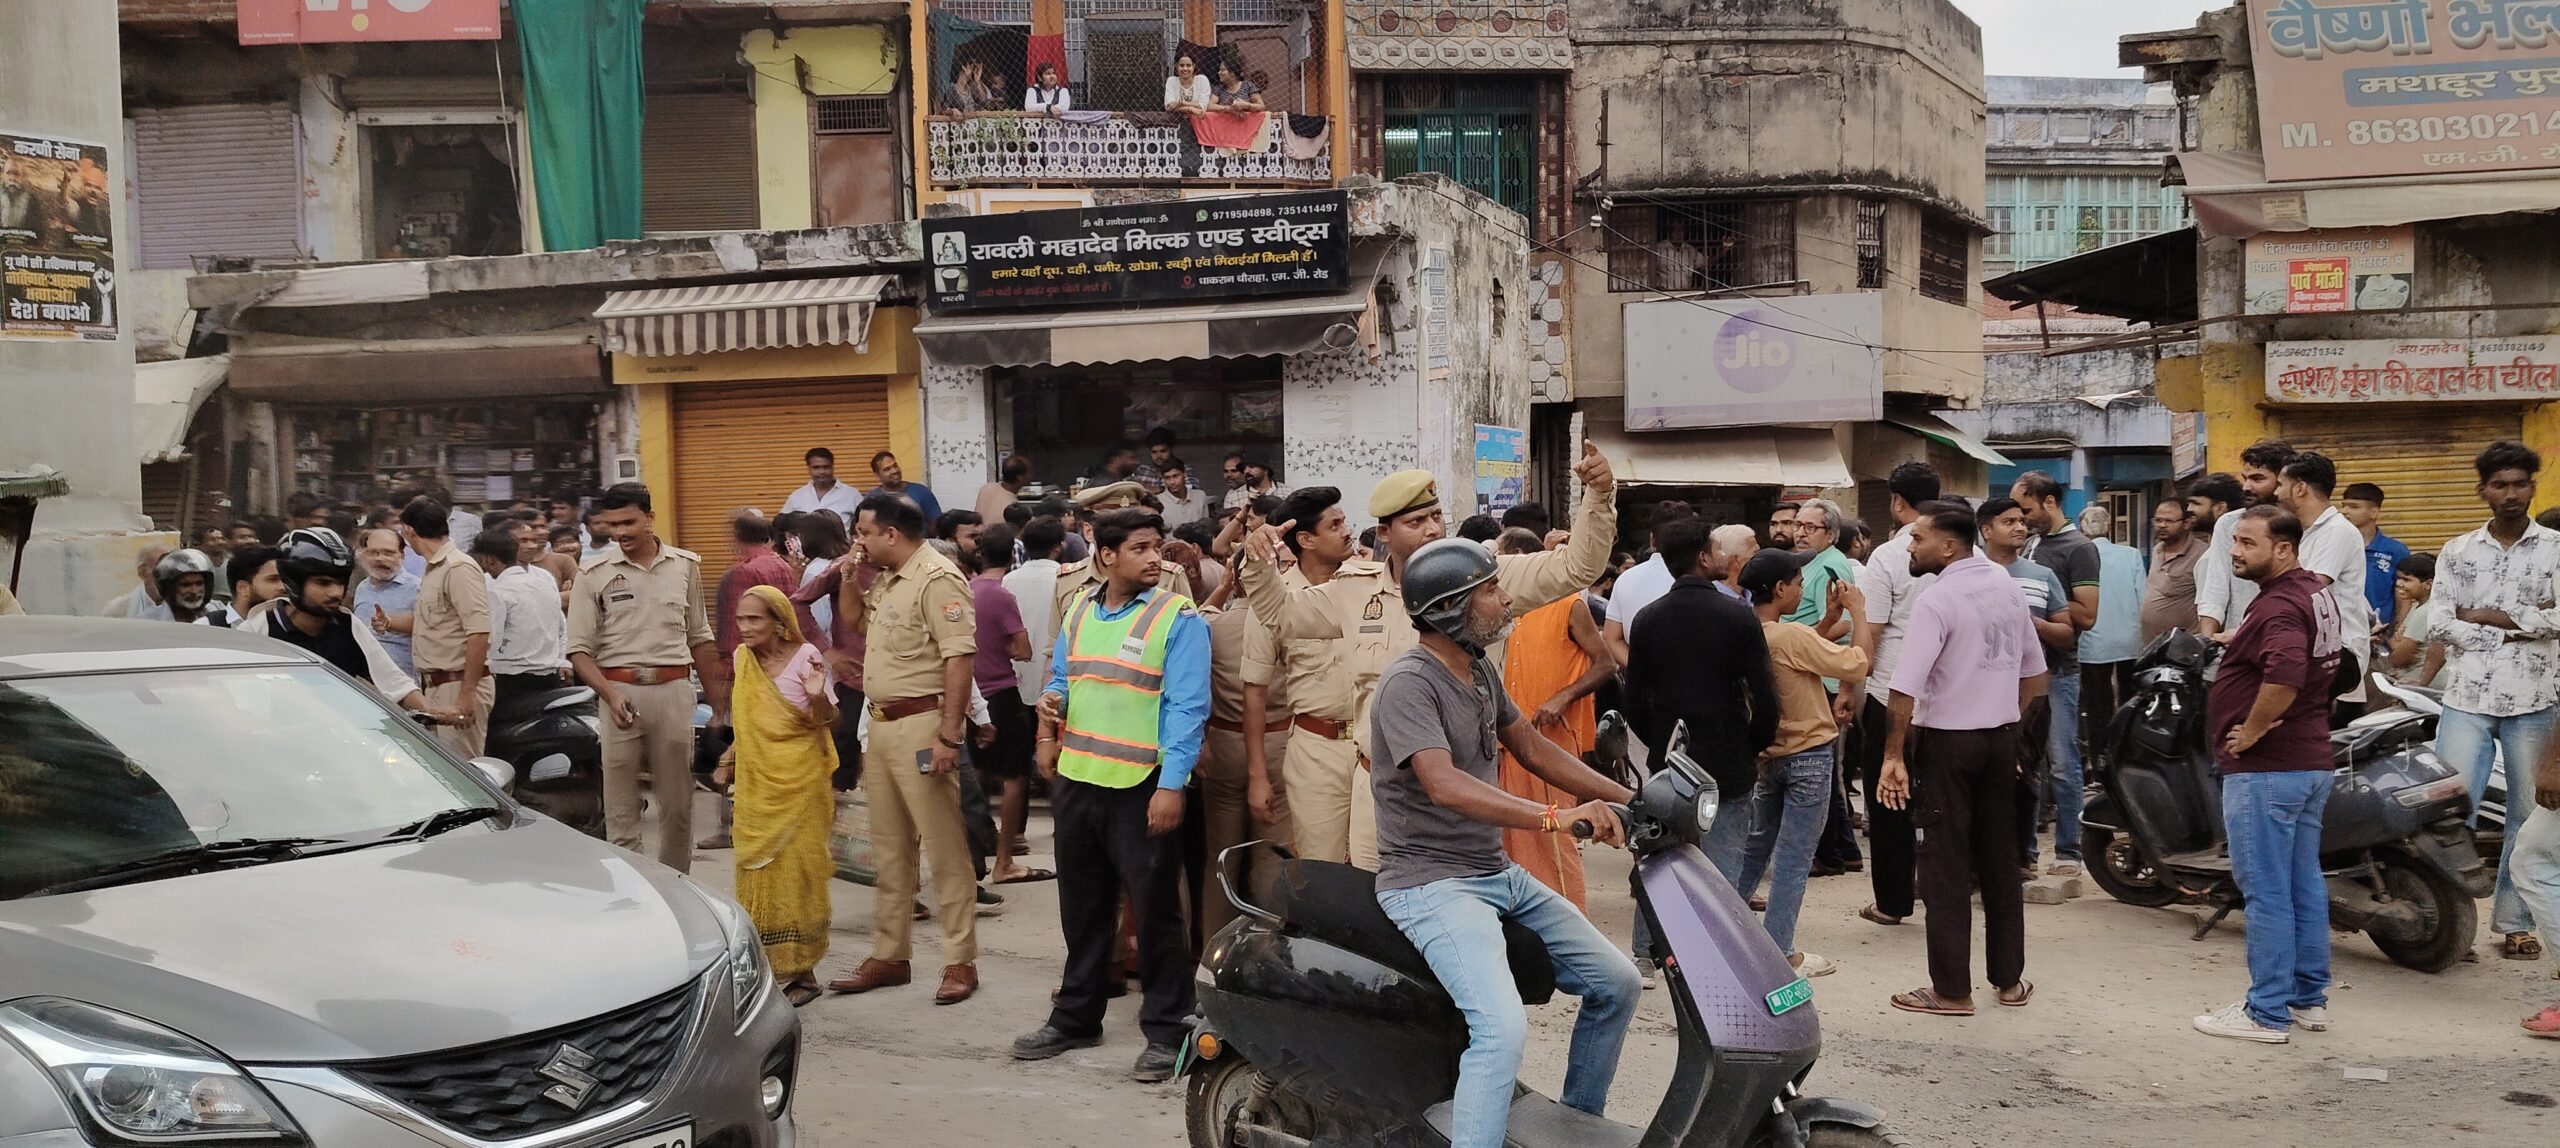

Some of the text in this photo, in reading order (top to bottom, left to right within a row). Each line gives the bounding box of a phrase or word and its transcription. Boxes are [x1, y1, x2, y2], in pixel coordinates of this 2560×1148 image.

[2357, 70, 2499, 97] मशहूर
[2280, 122, 2332, 148] M.
[53, 142, 80, 161] सेना
[1278, 203, 1338, 217] 7351414497
[971, 219, 1330, 260] रावली महादेव मिल्क एण्ड स्वीट्स
[991, 266, 1018, 279] हमारे
[1020, 264, 1041, 277] यहाँ
[1262, 250, 1299, 264] मिलती
[1313, 268, 1328, 279] रोड
[2290, 273, 2312, 290] पाव
[9, 297, 38, 320] देश
[1723, 330, 1790, 370] Jio
